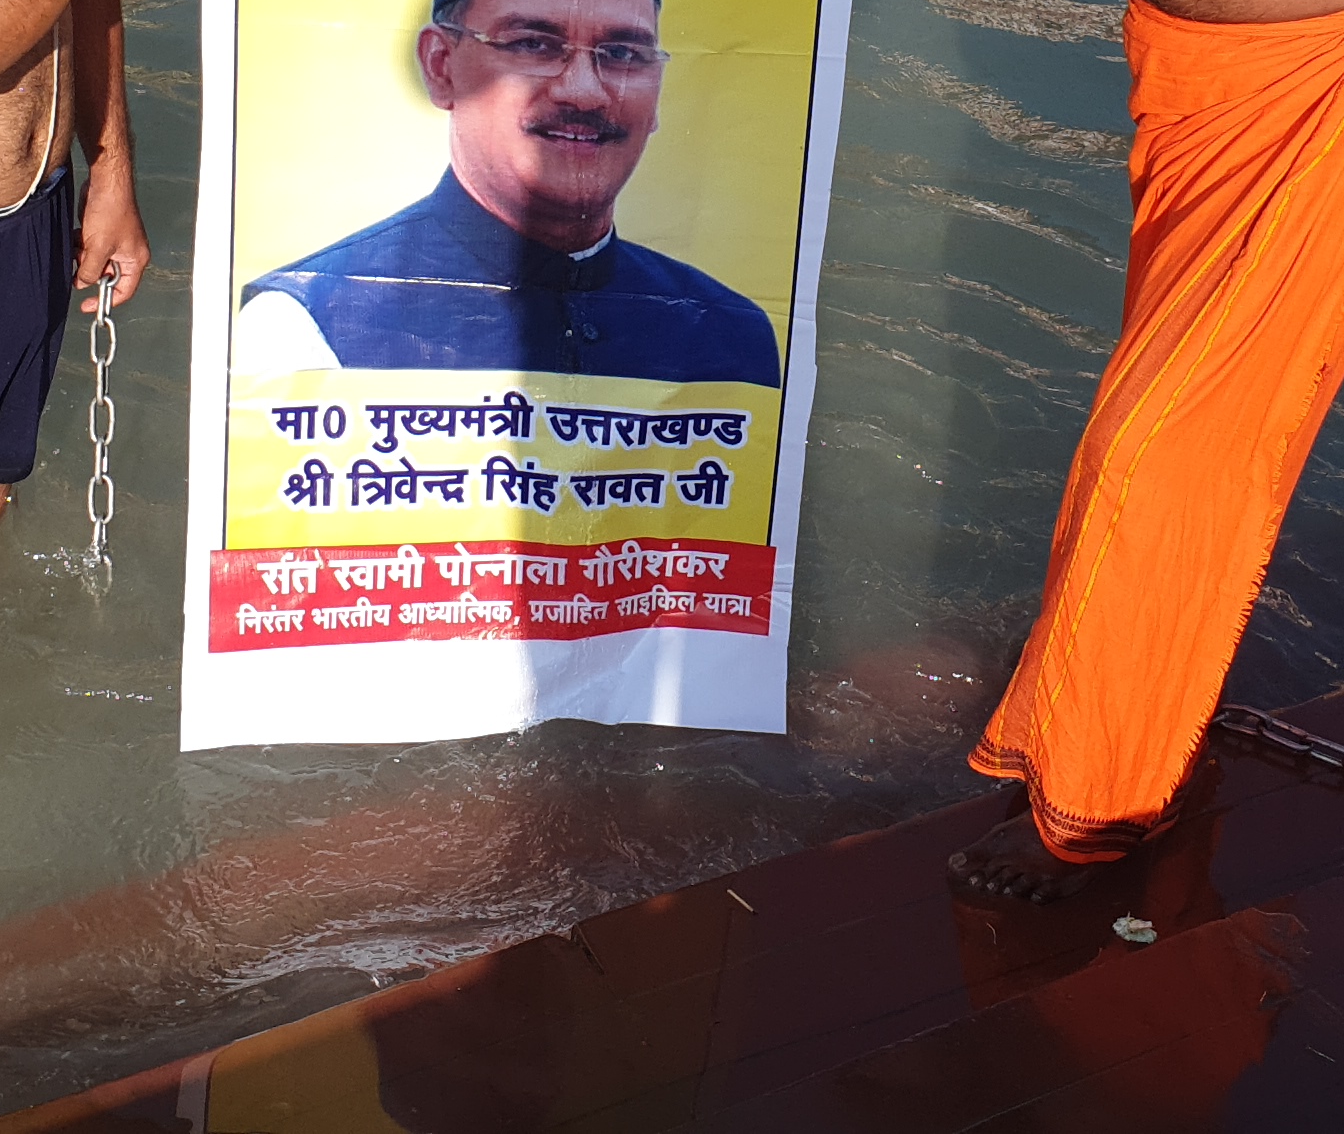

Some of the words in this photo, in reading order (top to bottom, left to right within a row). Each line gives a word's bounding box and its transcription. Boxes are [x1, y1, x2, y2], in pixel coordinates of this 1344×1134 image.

[365, 390, 534, 454] मुख्यमंत्री
[546, 406, 747, 447] उत्तराखण्ड
[283, 458, 334, 507] श्री
[346, 456, 469, 506] त्रिवेन्द्र
[481, 455, 559, 512] सिंह
[570, 472, 665, 506] रावत
[676, 460, 730, 505] जी
[328, 544, 425, 591] स्वामी
[434, 542, 568, 586] पोन्नाला
[579, 540, 730, 588] गौरीशंकर
[235, 603, 306, 635] निरंतर
[311, 596, 392, 630] भारतीय
[398, 592, 521, 626] आध्यात्मिक,
[529, 593, 610, 624] प्रजाहित
[615, 584, 697, 617] साइकिल
[702, 592, 753, 617] यात्रा
